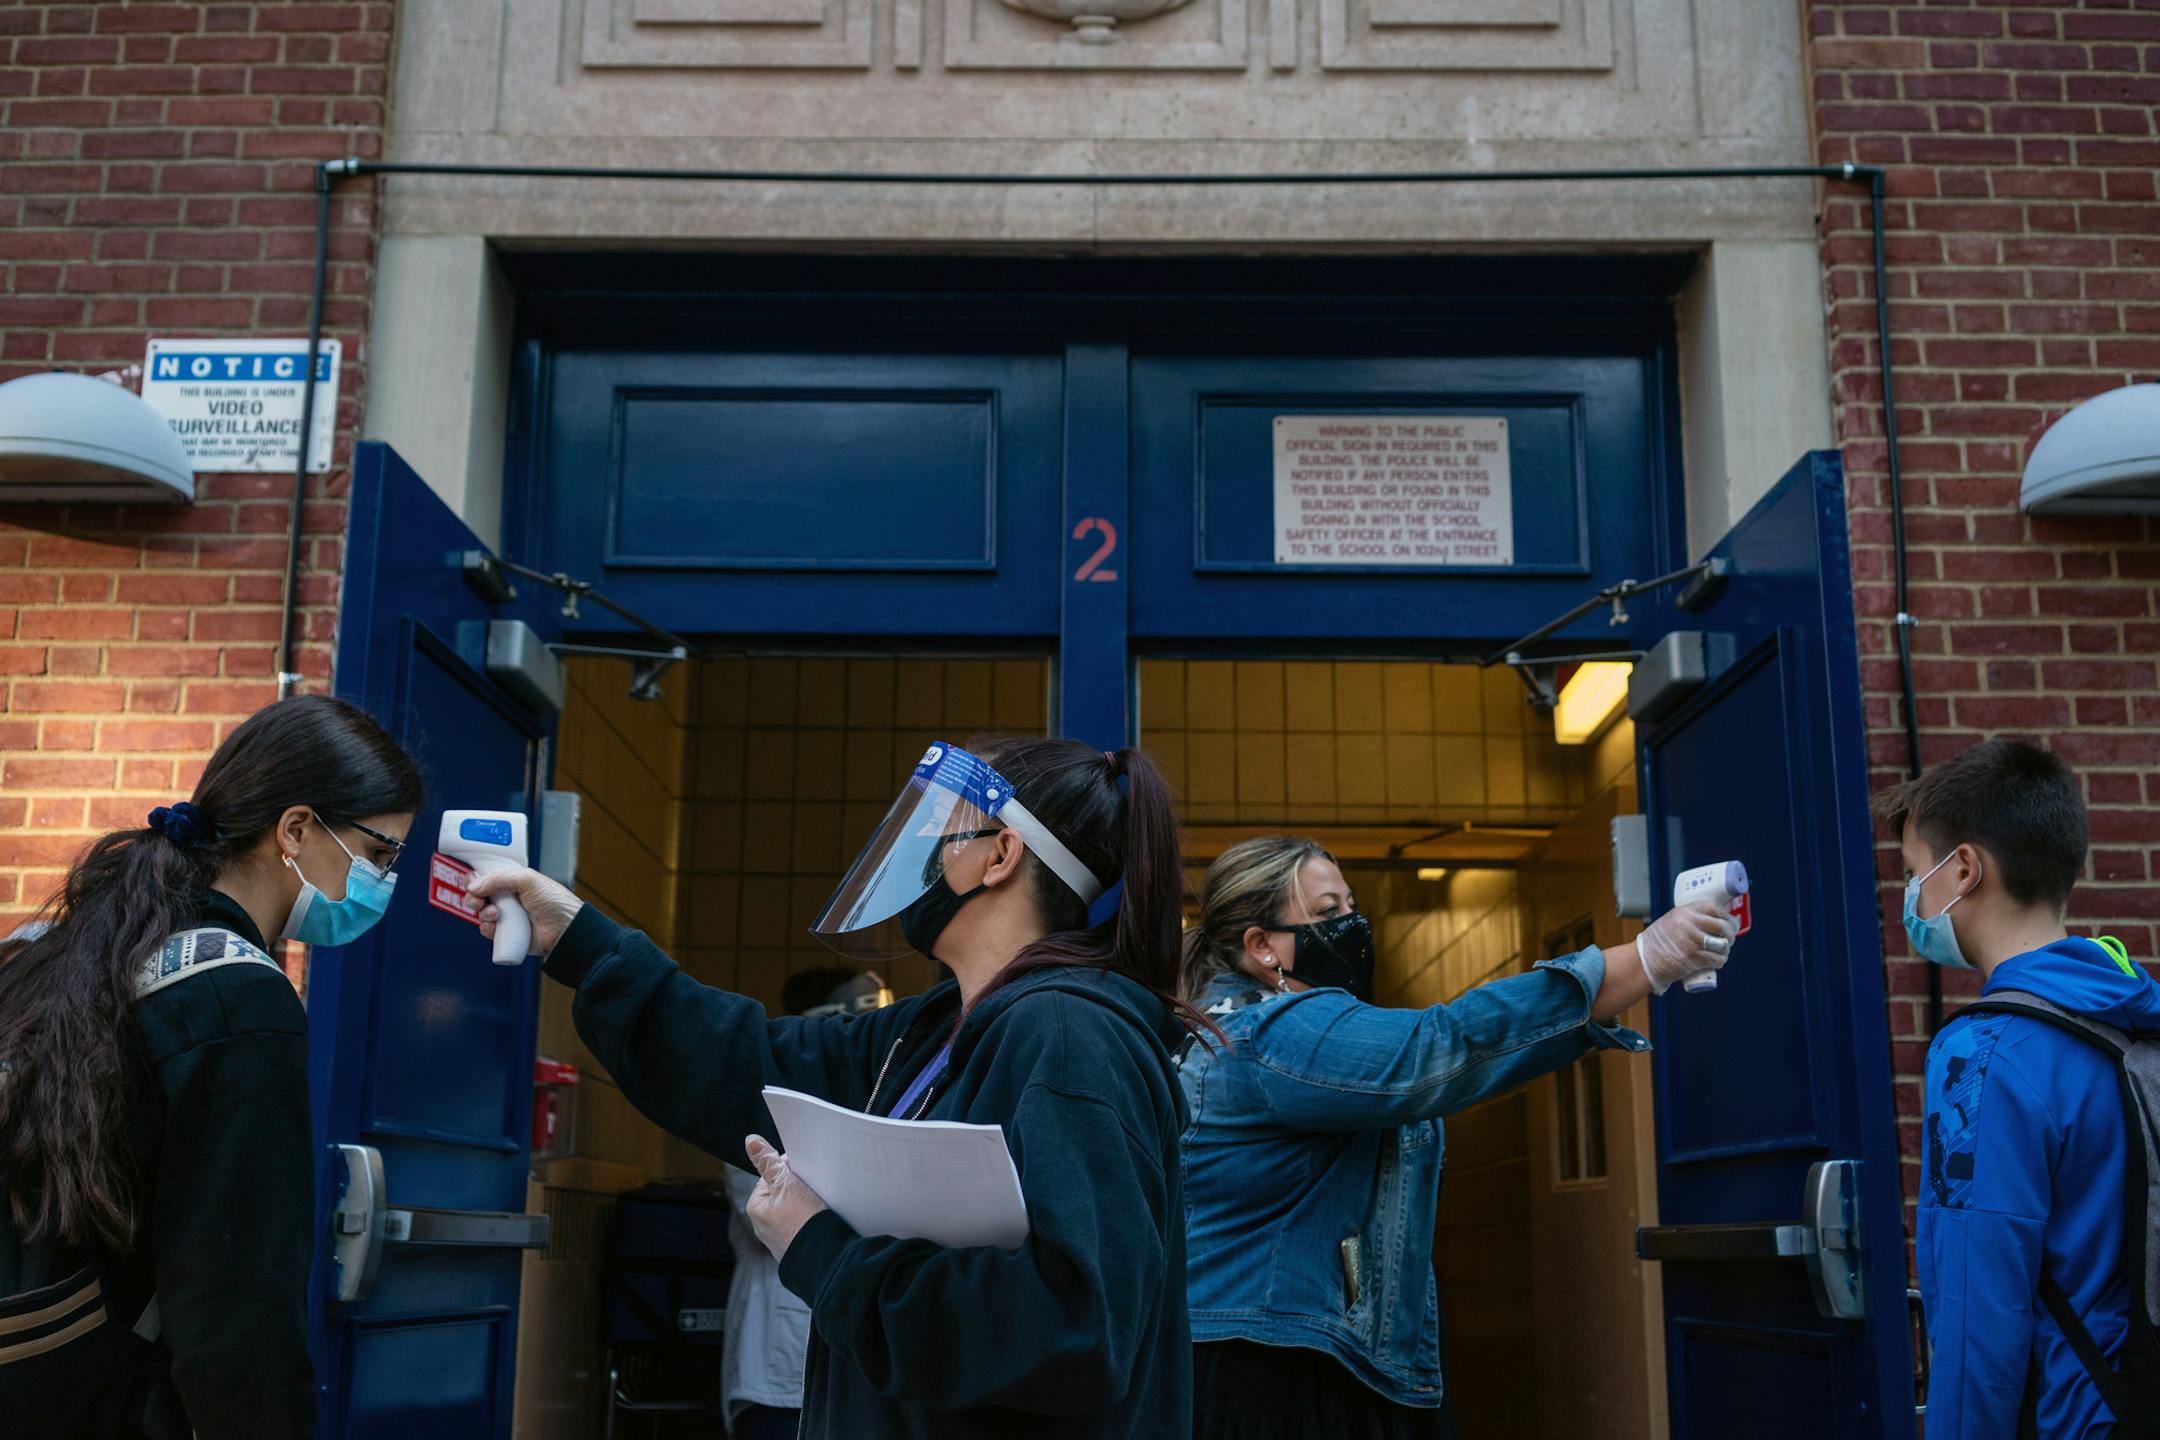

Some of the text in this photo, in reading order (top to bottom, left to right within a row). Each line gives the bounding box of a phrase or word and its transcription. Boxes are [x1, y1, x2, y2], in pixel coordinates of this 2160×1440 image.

[180, 387, 296, 397] THIS BUILDING IS UNDER
[208, 400, 264, 416] VIDEO
[1318, 425, 1465, 438] WARNING TO THE PUBLIC
[1286, 440, 1337, 453] OFFICIAL
[1391, 440, 1452, 453] REQUIRED
[1455, 440, 1469, 453] IN
[1472, 440, 1499, 453] THIS
[1360, 455, 1383, 468] THE
[1387, 455, 1429, 468] POLICE
[1434, 455, 1461, 468] WILL
[1464, 455, 1481, 468] BE
[1291, 469, 1490, 482] NOTIFIED IF ANY PERSON ENTERS
[1292, 484, 1491, 497] THIS BUILDING OR FOUND IN THIS
[1301, 499, 1481, 512] BUILDING WITHOUT OFFICIALLY
[1302, 514, 1481, 527] SIGNING IN WITH THE SCHOOL
[1286, 529, 1498, 542] SAFETY OFFICER AT THE ENTRANCE
[1072, 517, 1118, 582] 2
[1291, 544, 1307, 557] TO
[1312, 544, 1333, 557] THE
[1338, 544, 1388, 557] SCHOOL
[1392, 544, 1411, 557] ON
[1454, 544, 1499, 557] STREET
